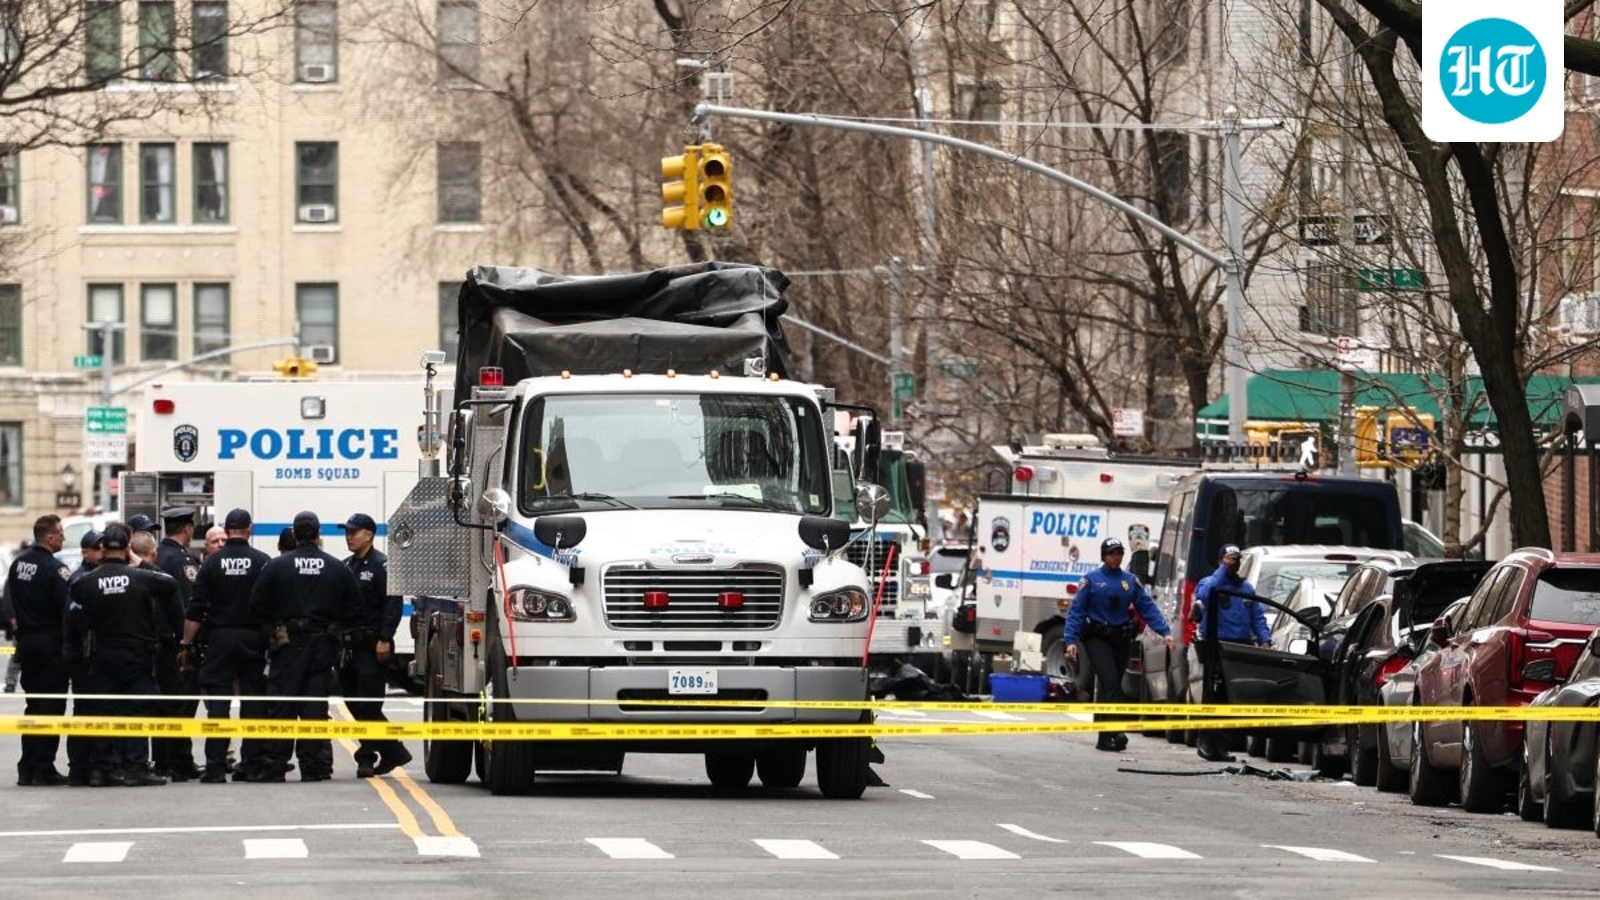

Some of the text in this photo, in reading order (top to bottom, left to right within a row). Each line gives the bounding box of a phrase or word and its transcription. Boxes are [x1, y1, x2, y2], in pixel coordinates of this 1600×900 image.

[218, 429, 398, 459] POLICE
[276, 468, 360, 479] BOMB SQUAD
[1030, 511, 1100, 538] POLICE
[16, 561, 38, 575] NYPD
[221, 558, 252, 570] NYPD
[294, 558, 325, 569] NYPD
[1029, 559, 1070, 572] EMERGENCY
[98, 575, 130, 589] NYPD
[672, 675, 704, 688] 7089
